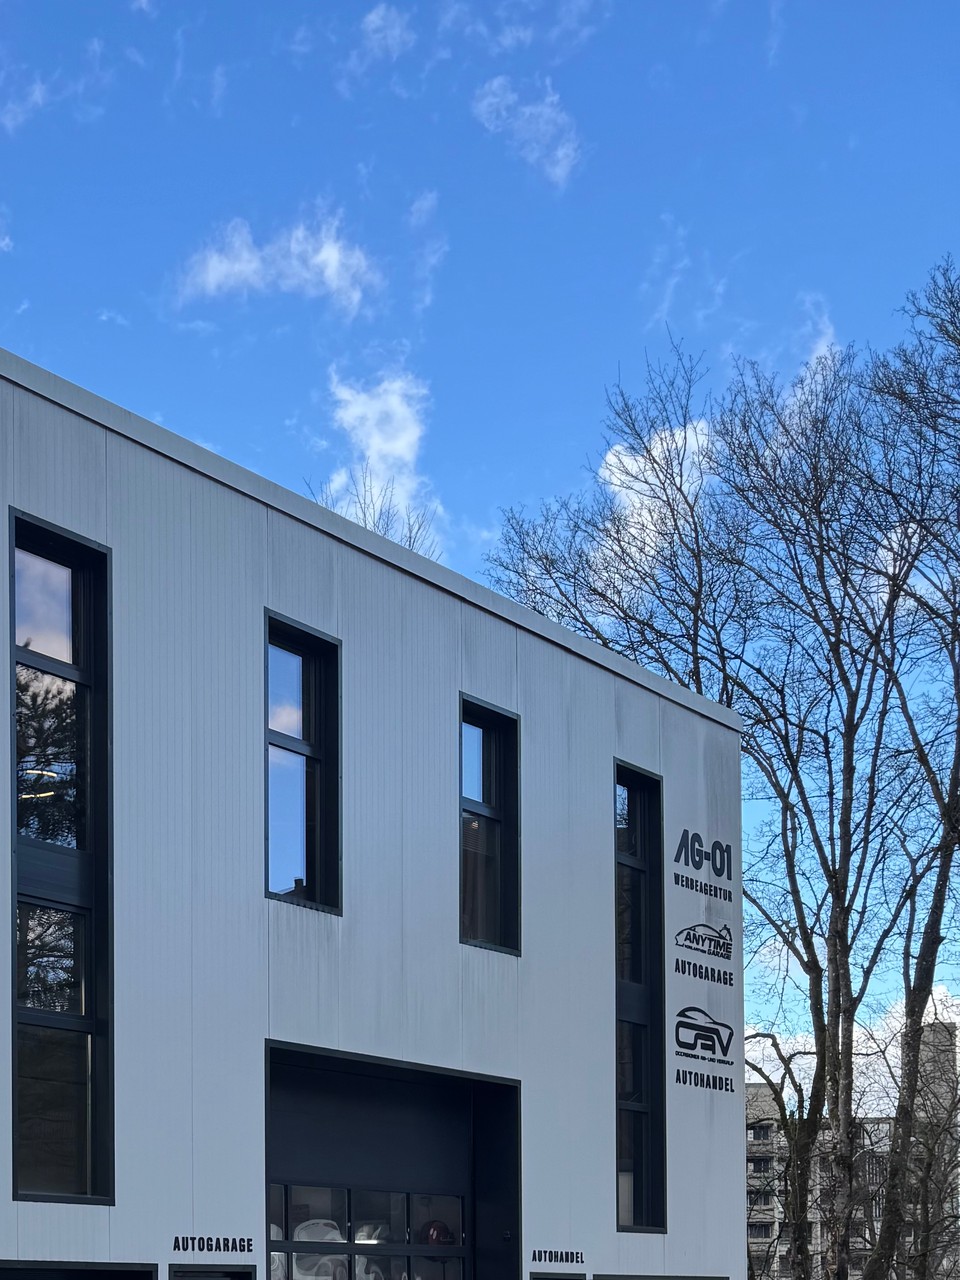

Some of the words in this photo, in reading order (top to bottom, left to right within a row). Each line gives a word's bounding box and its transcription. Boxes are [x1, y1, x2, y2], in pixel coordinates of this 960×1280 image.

[674, 828, 732, 881] AG-01
[674, 872, 732, 903] WERBEAGENTUR
[684, 931, 733, 954] ANYTIME
[675, 958, 734, 987] AUTOGARAGE
[675, 1068, 735, 1093] AUTOHANDEL
[173, 1236, 253, 1253] AUTOGARAGE
[531, 1249, 585, 1264] AUTOHANDEL
